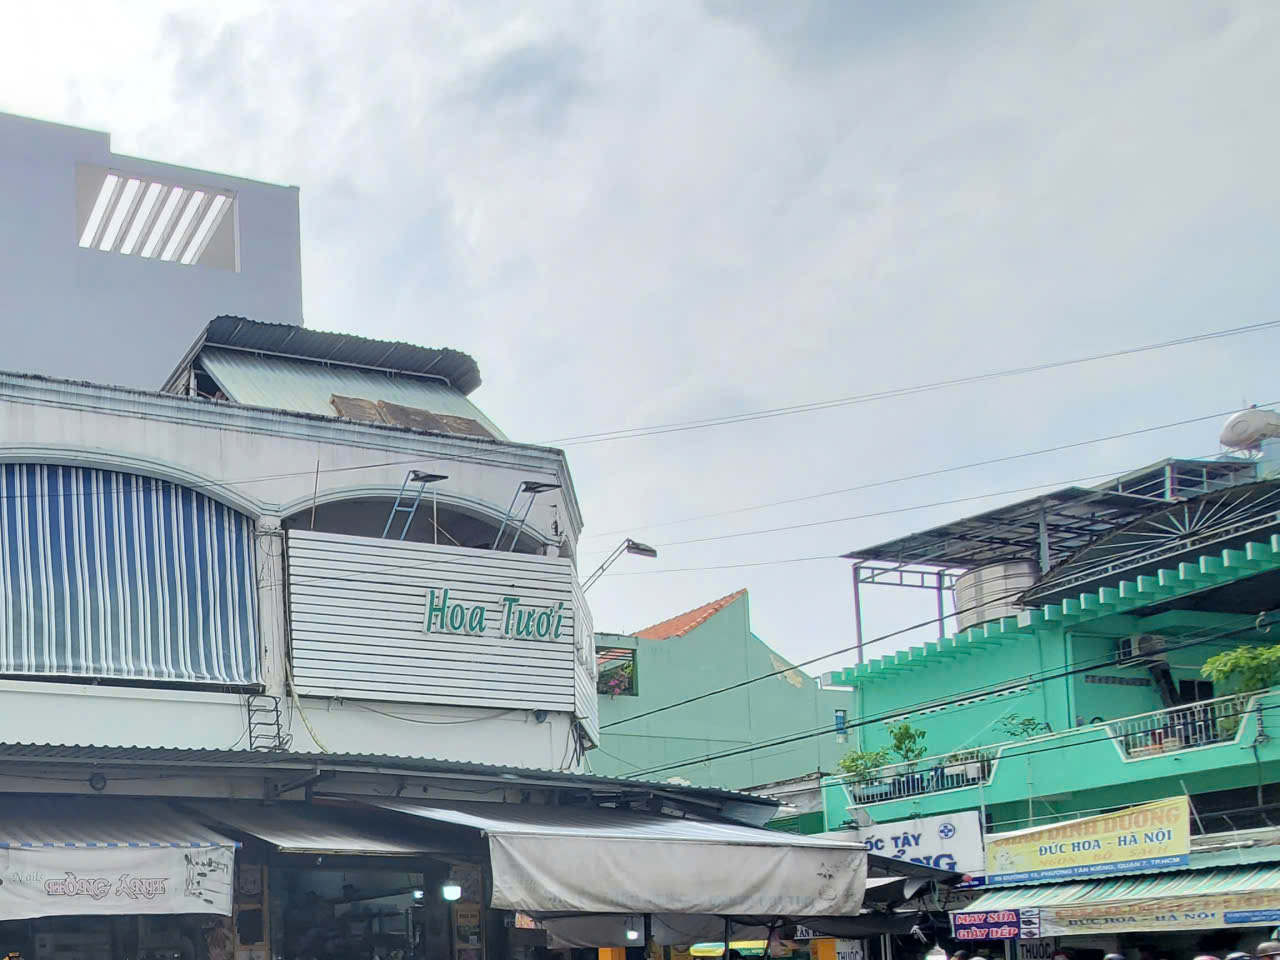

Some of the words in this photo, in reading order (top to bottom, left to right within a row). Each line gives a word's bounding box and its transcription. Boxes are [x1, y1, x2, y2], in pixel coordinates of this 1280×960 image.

[425, 588, 487, 633] Hoa
[500, 596, 565, 640] Tươi
[891, 831, 922, 849] TÂY
[1038, 840, 1067, 857] ĐỨC
[1071, 838, 1102, 853] HOA
[1117, 827, 1138, 847] HÀ
[1143, 823, 1173, 845] NỘI
